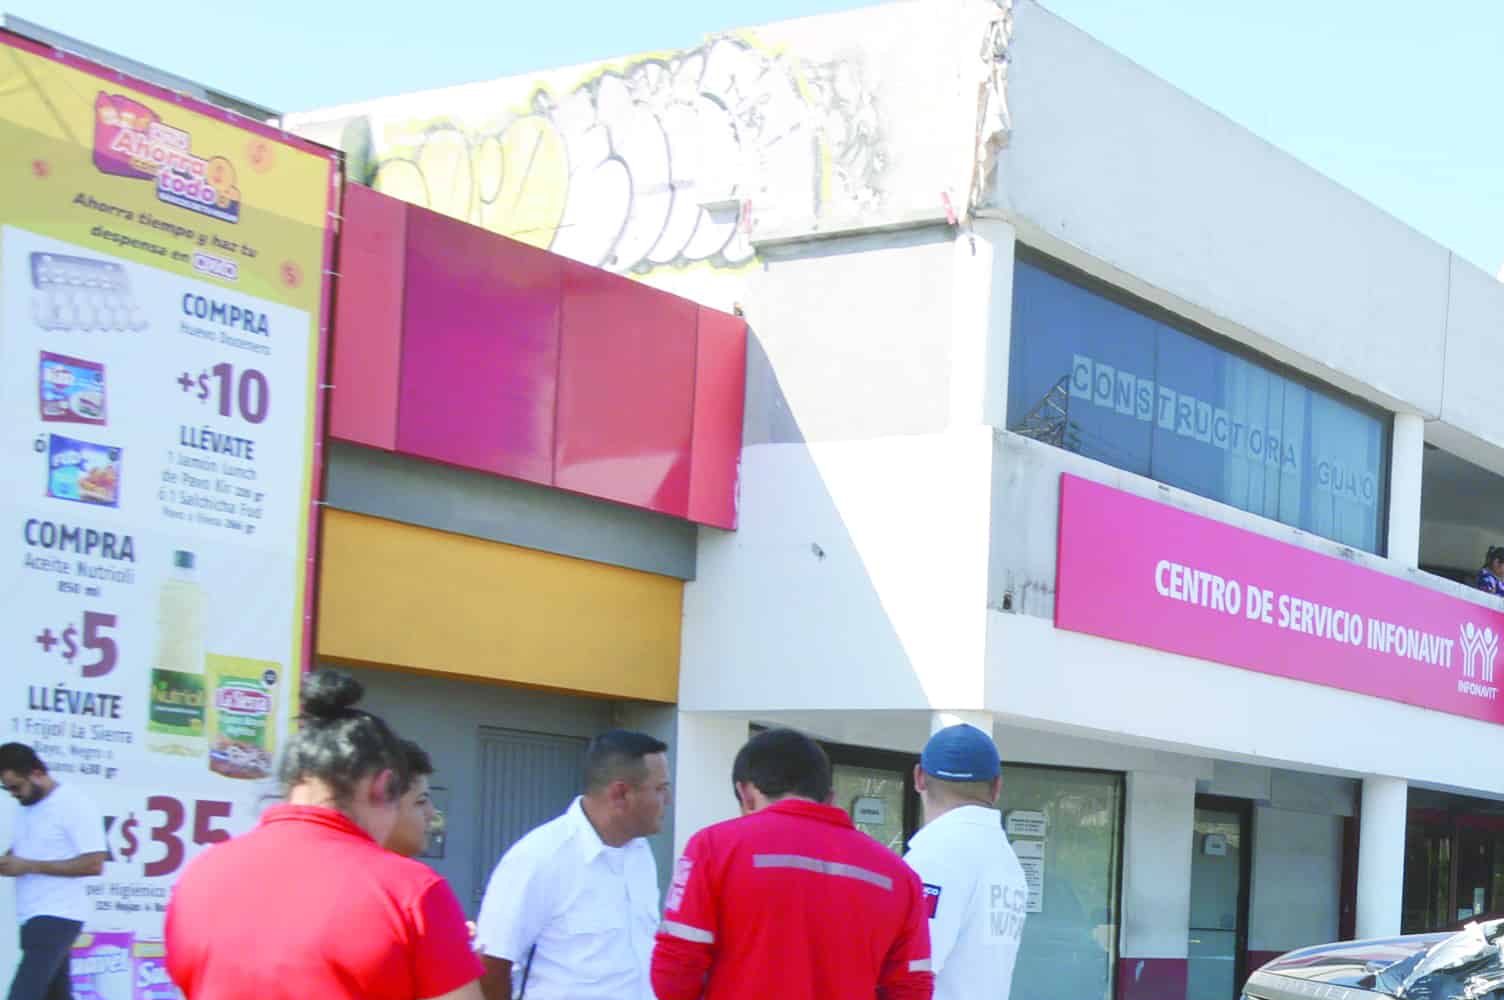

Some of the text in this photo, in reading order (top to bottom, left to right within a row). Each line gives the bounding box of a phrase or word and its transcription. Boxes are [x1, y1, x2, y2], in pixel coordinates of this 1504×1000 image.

[111, 127, 208, 177] Ahorra
[159, 170, 217, 204] todo
[72, 192, 134, 221] Ahorra
[138, 211, 196, 239] tiempo
[90, 225, 169, 256] despensa
[170, 250, 191, 263] en
[182, 292, 269, 338] COMPRA
[1072, 362, 1297, 469] CONSTRUCTORA
[179, 424, 257, 461] LLÉVATE
[24, 518, 136, 564] COMPRA
[24, 552, 72, 576] Aceite
[1154, 559, 1455, 669] CENTRO DE SERVICIO INFONAVIT
[35, 609, 119, 679] +$5
[28, 681, 123, 720] LLÉVATE
[1457, 678, 1499, 701] INFONAVIT
